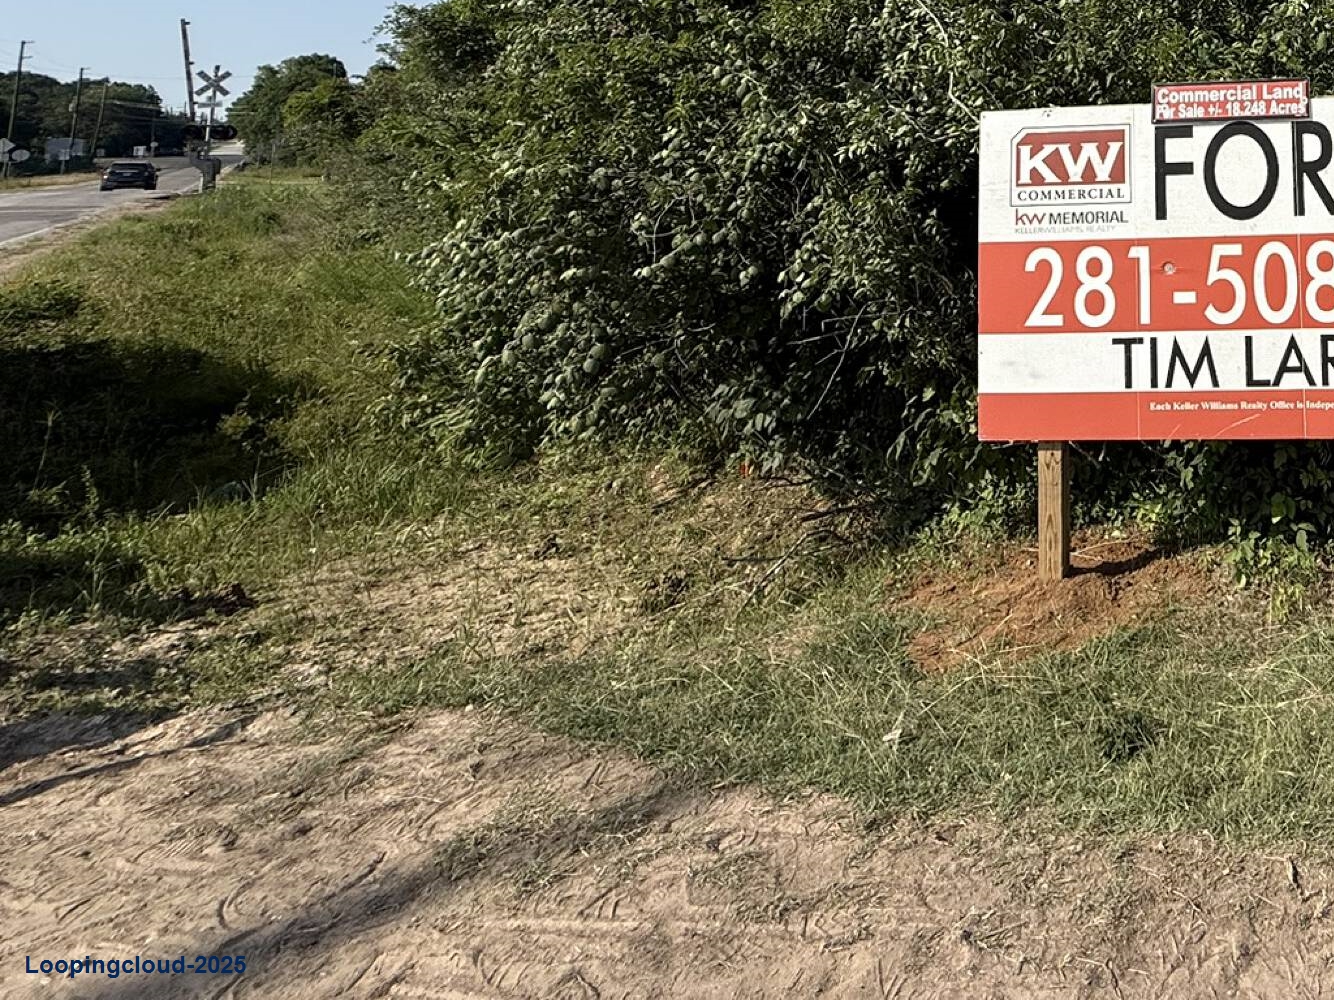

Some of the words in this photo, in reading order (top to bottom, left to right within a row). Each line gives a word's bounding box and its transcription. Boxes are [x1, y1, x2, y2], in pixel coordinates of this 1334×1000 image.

[1158, 85, 1256, 103] Commercial
[1262, 82, 1303, 100] Land
[1179, 103, 1204, 117] Sale
[1226, 101, 1265, 116] 18.248
[1270, 100, 1306, 114] Acres
[1018, 142, 1123, 184] KW
[1018, 188, 1124, 201] COMMERCIAL
[1049, 210, 1128, 224] MEMORIAL
[1112, 335, 1220, 388] TIM
[1150, 402, 1171, 411] Each
[1173, 401, 1199, 411] Keller
[1201, 401, 1238, 410] Williams
[1240, 401, 1267, 412] Realty
[1270, 401, 1294, 410] Office
